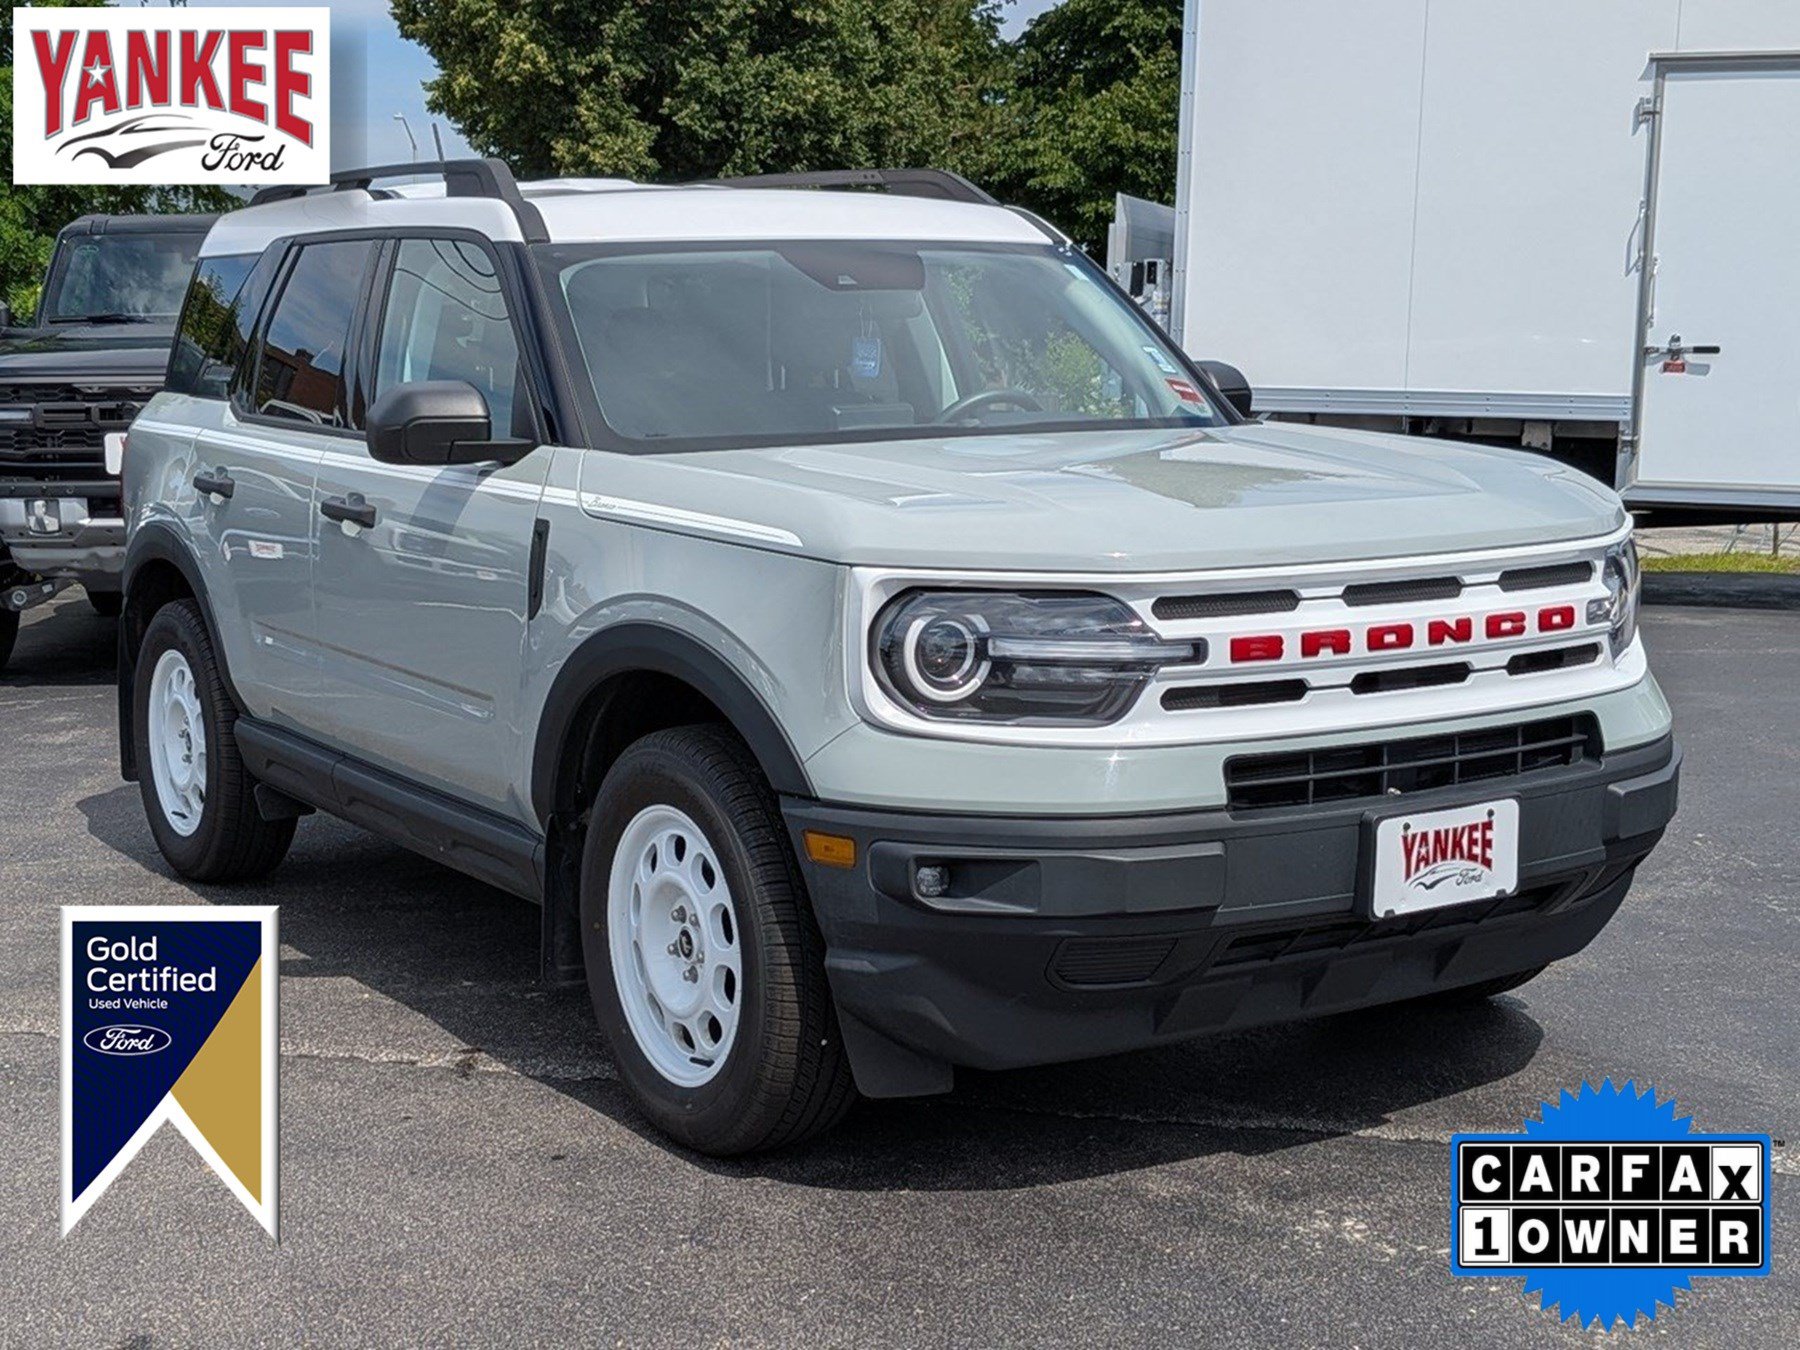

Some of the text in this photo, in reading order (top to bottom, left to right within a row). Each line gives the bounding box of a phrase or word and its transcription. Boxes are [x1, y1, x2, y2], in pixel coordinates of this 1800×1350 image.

[1230, 605, 1575, 664] BRONCO
[1401, 819, 1494, 883] YANKEE
[1455, 868, 1485, 887] Ford
